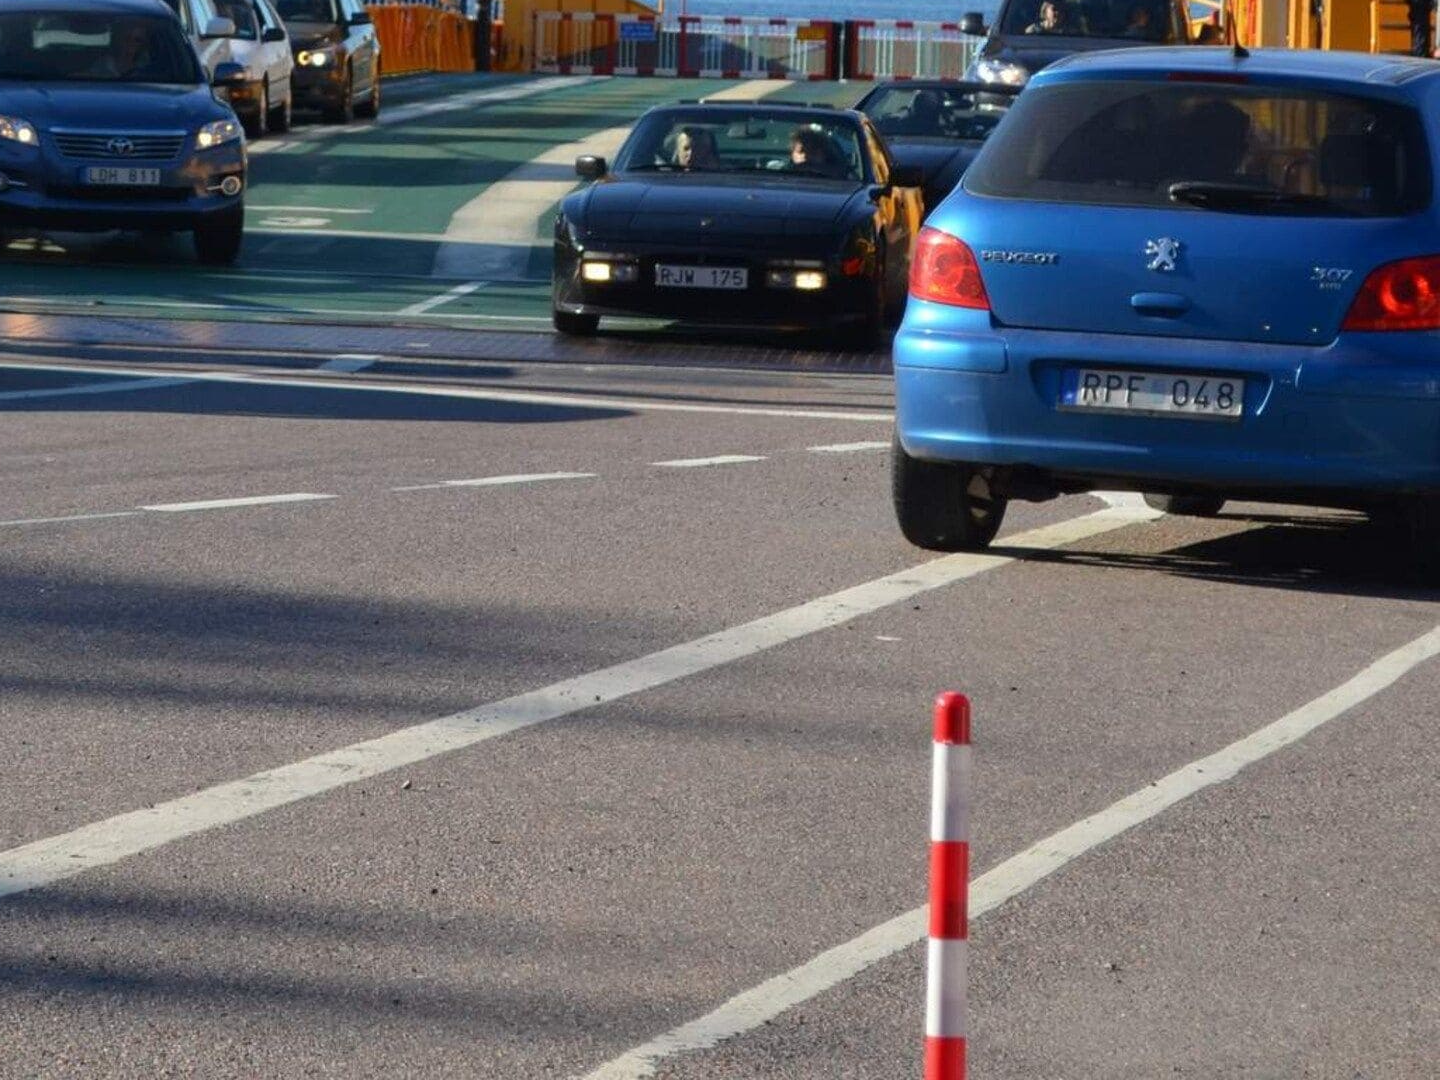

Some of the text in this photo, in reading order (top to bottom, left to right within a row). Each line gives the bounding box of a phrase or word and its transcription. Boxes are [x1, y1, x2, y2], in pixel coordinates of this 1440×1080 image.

[981, 249, 1058, 264] PEUGEOT
[711, 269, 743, 286] 175
[1083, 373, 1235, 410] RPF 048
